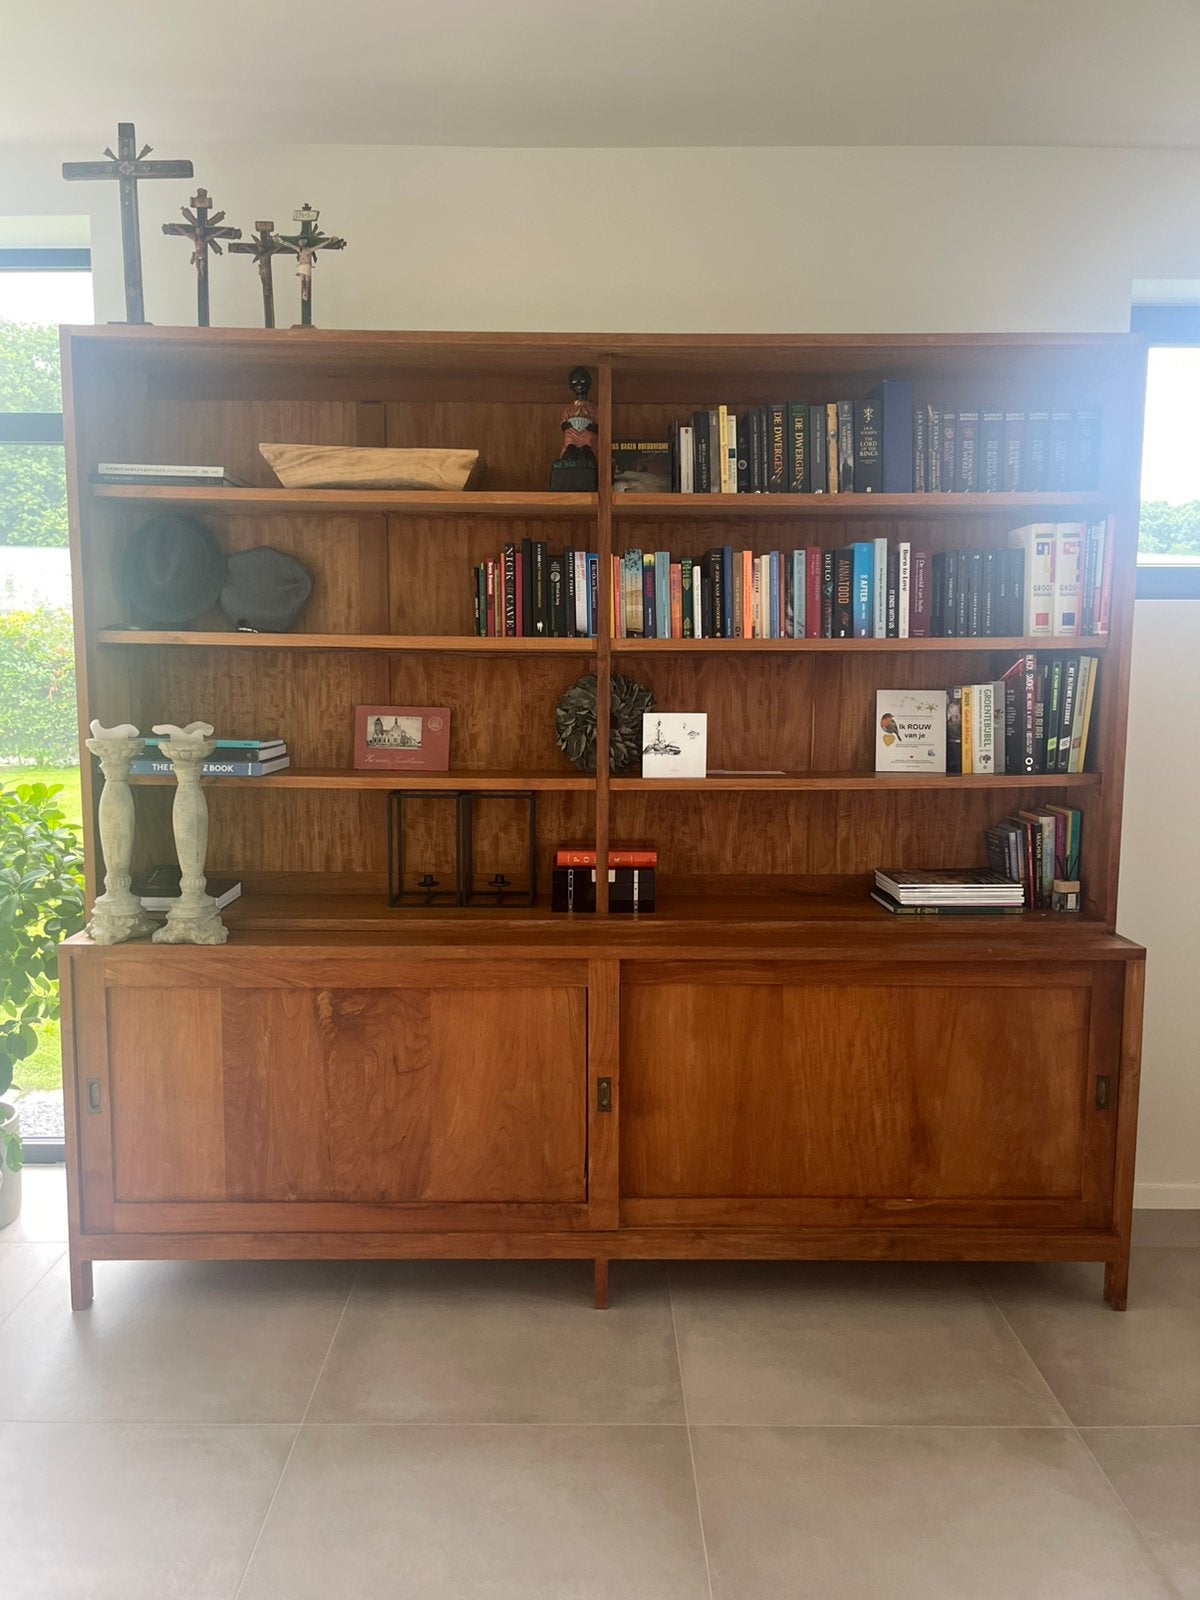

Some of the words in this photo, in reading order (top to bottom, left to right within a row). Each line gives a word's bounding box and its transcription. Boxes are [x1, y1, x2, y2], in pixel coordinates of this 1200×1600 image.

[774, 412, 782, 424] DE
[795, 418, 803, 430] DE
[774, 427, 782, 473] DWERGEN
[795, 432, 803, 479] DWERGEN
[506, 547, 514, 580] NICK
[838, 560, 850, 581] ANNA
[838, 581, 850, 604] TODD
[860, 580, 868, 602] AFTER
[506, 595, 514, 628] CAVE
[1026, 654, 1034, 671] BLACK
[1026, 673, 1034, 692] SMOKE
[209, 764, 234, 772] BOOK
